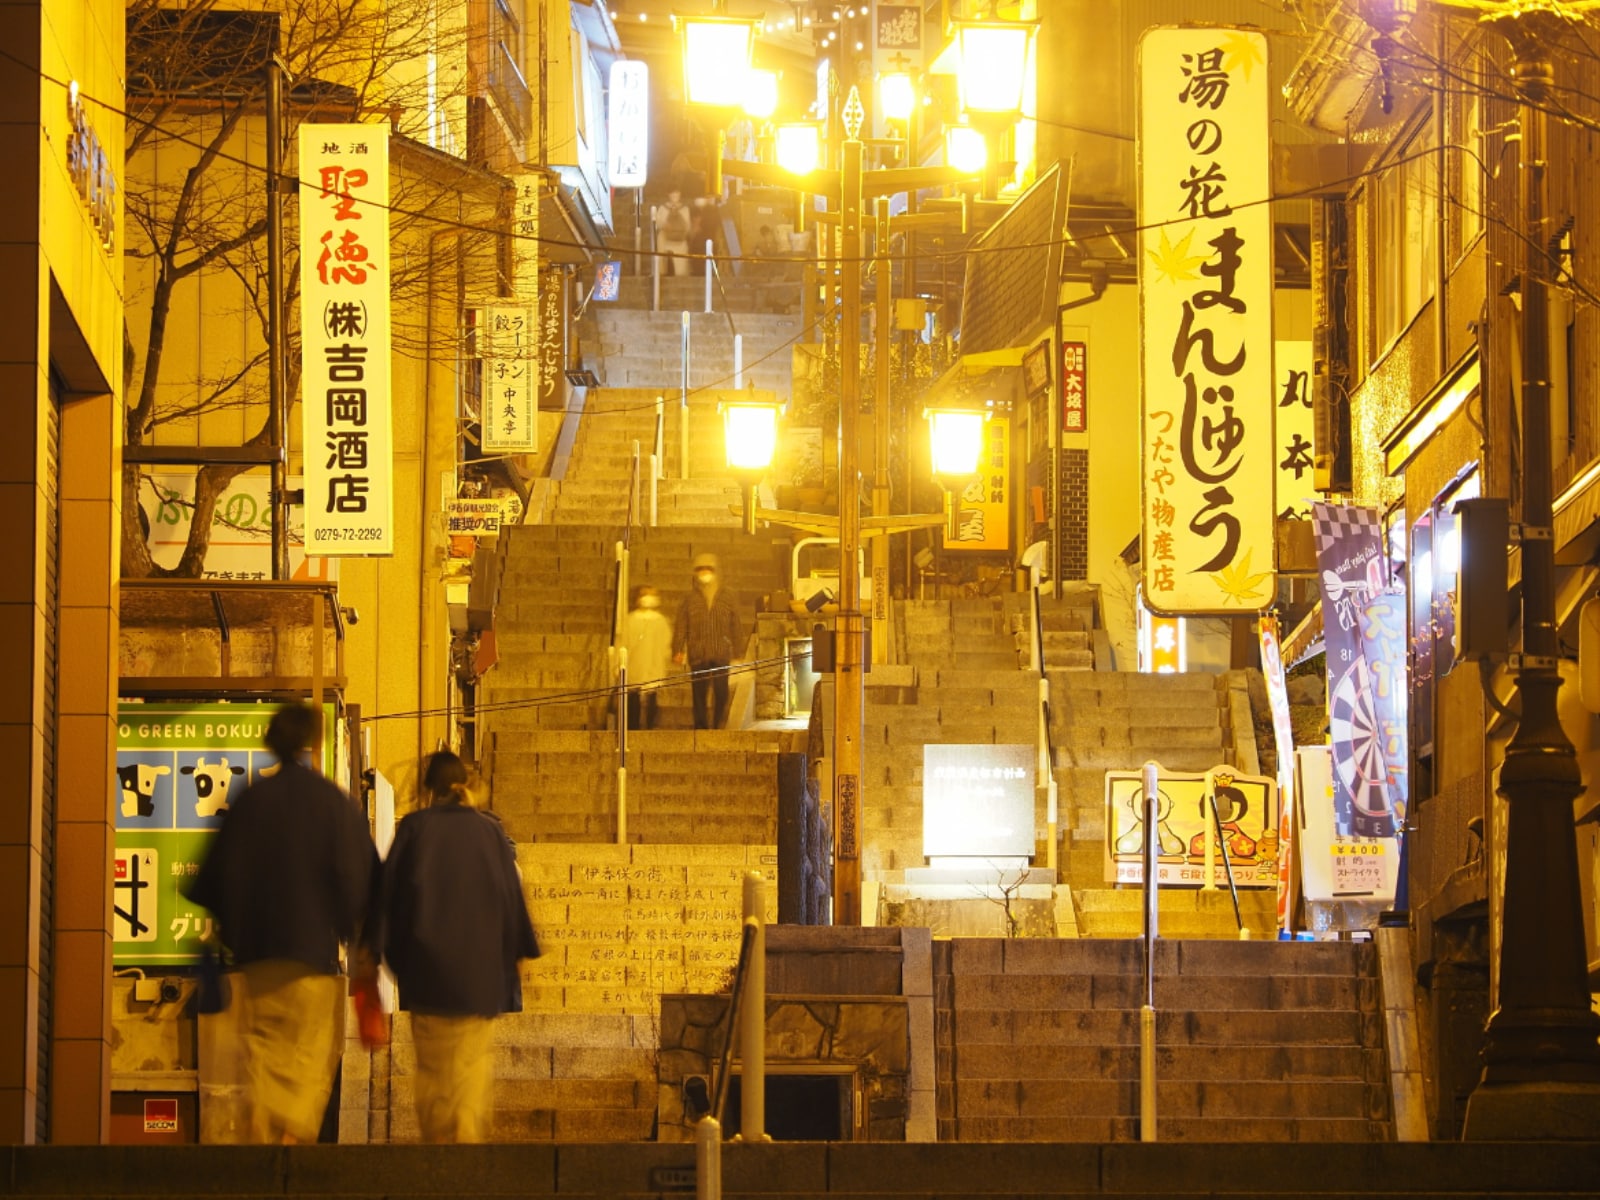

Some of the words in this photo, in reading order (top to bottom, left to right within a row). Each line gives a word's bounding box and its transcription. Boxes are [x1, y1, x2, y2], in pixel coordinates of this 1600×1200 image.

[321, 142, 369, 155] 地酒
[316, 165, 378, 286] 聖徳
[1172, 48, 1247, 575] 湯の花まんじゅう
[494, 314, 510, 379] 餃子
[511, 316, 525, 379] ラーメン
[503, 387, 517, 435] 中央亭
[449, 517, 498, 531] 推奨の店
[1149, 410, 1176, 592] つたや物産店
[314, 527, 382, 541] 0279-72-2292
[138, 724, 196, 739] GREEN
[204, 723, 270, 739] BOKUJ
[146, 1121, 175, 1129] SECOM
